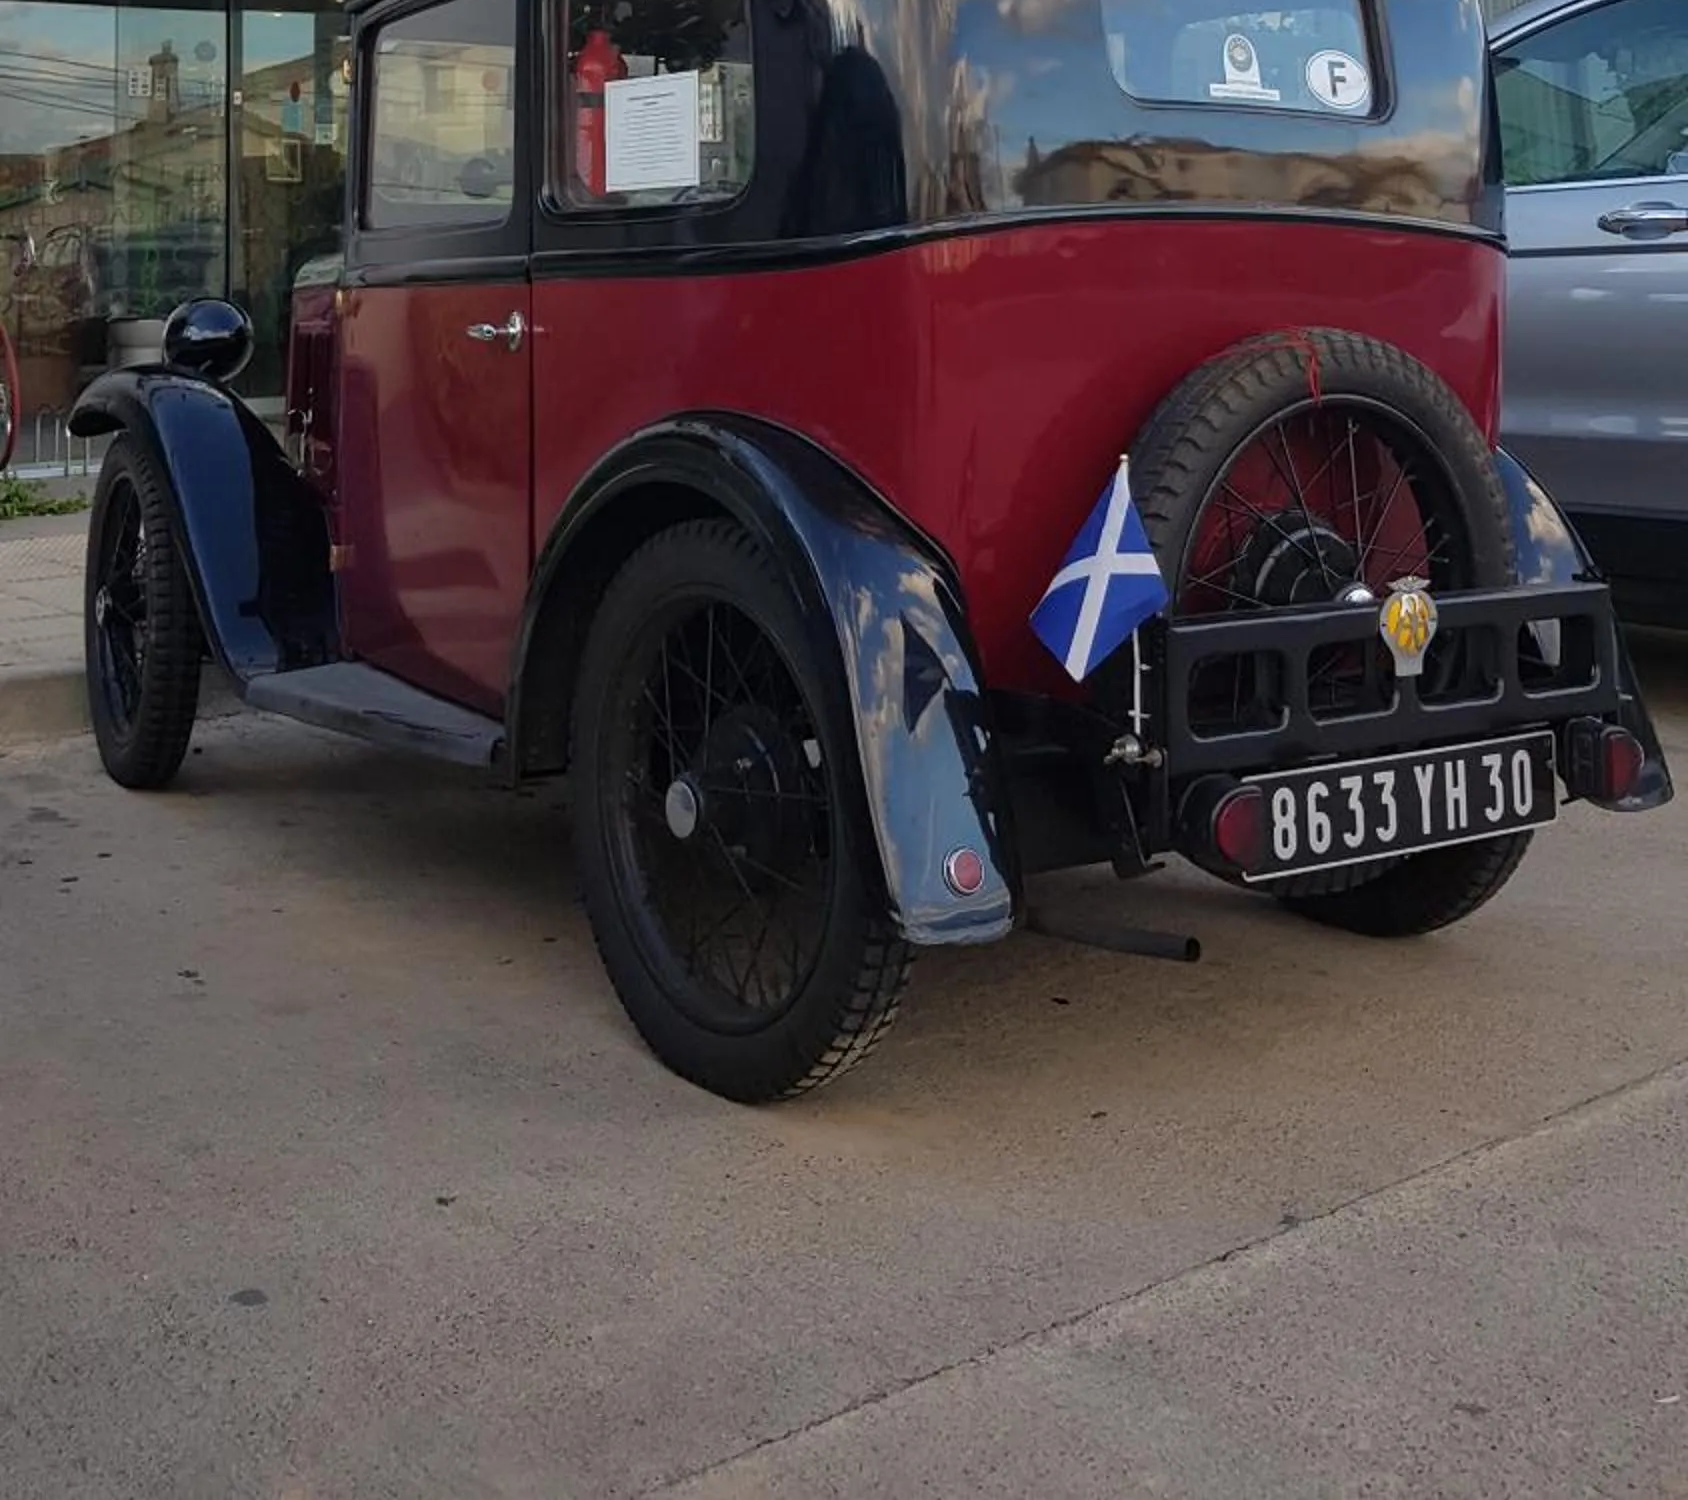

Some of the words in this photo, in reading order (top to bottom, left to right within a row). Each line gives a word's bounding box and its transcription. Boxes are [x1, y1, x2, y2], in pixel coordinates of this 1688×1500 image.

[1327, 60, 1348, 98] F
[1271, 770, 1398, 862] 8633
[1412, 758, 1469, 836] YH
[1480, 748, 1534, 823] 30
